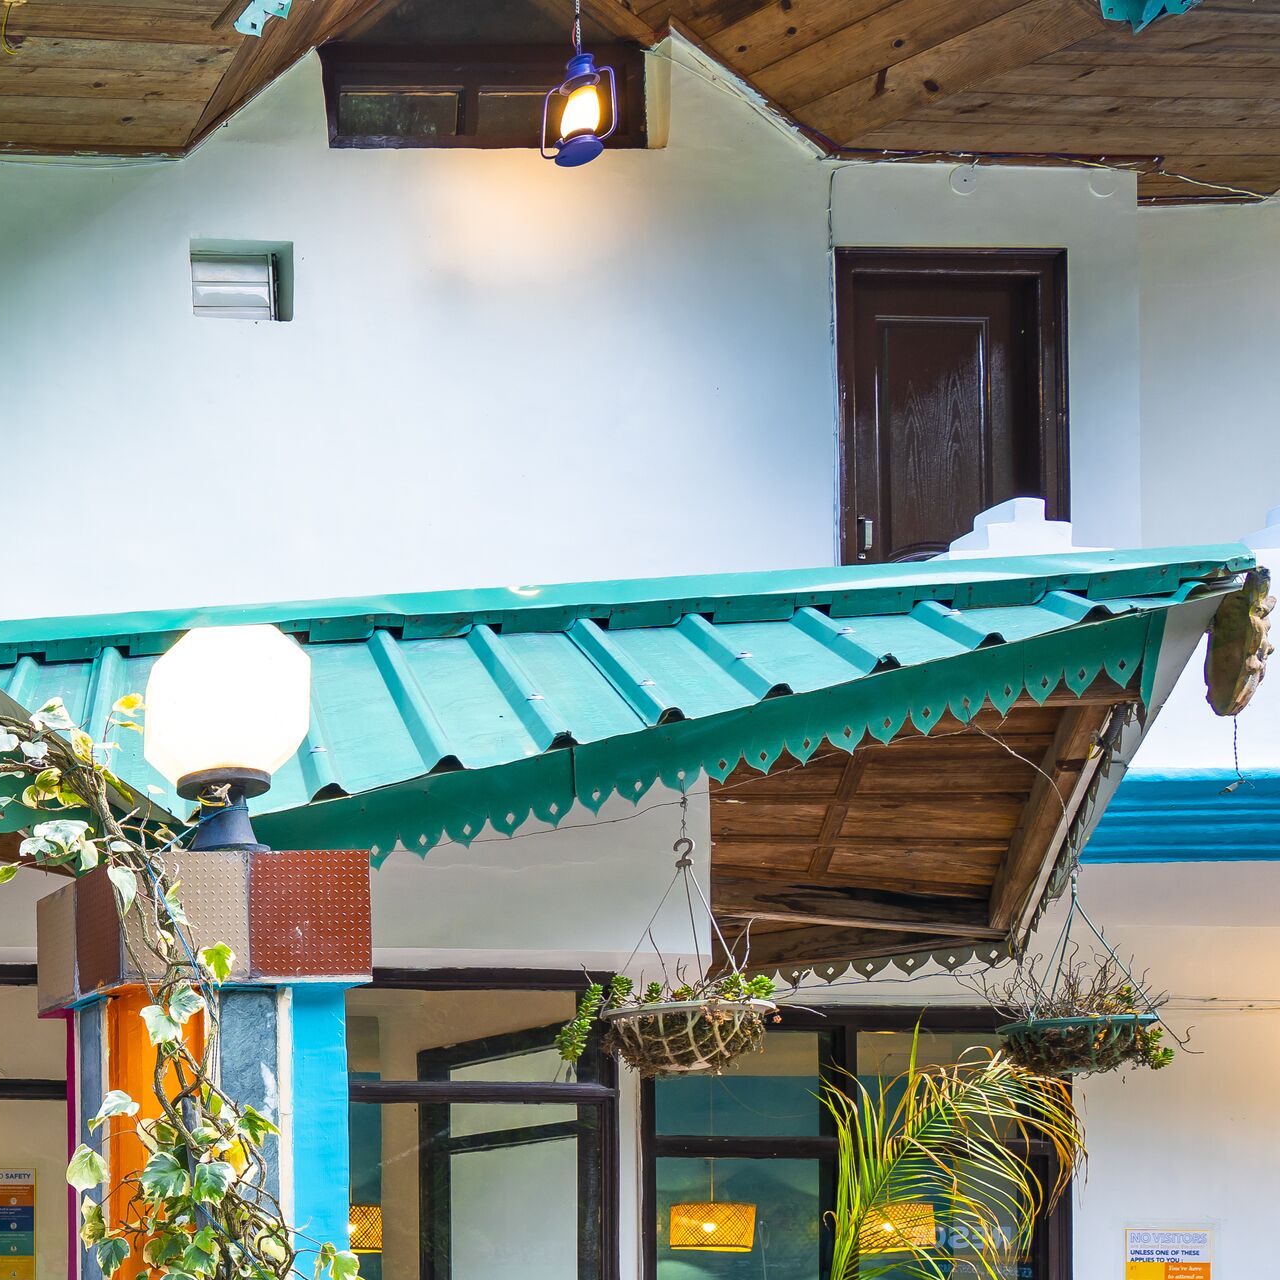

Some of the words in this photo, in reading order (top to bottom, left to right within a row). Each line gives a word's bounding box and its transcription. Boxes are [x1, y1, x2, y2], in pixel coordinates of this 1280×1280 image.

[5, 1172, 31, 1180] SAFETY
[1130, 1232, 1151, 1244] NO
[1152, 1232, 1207, 1244] VISITORS
